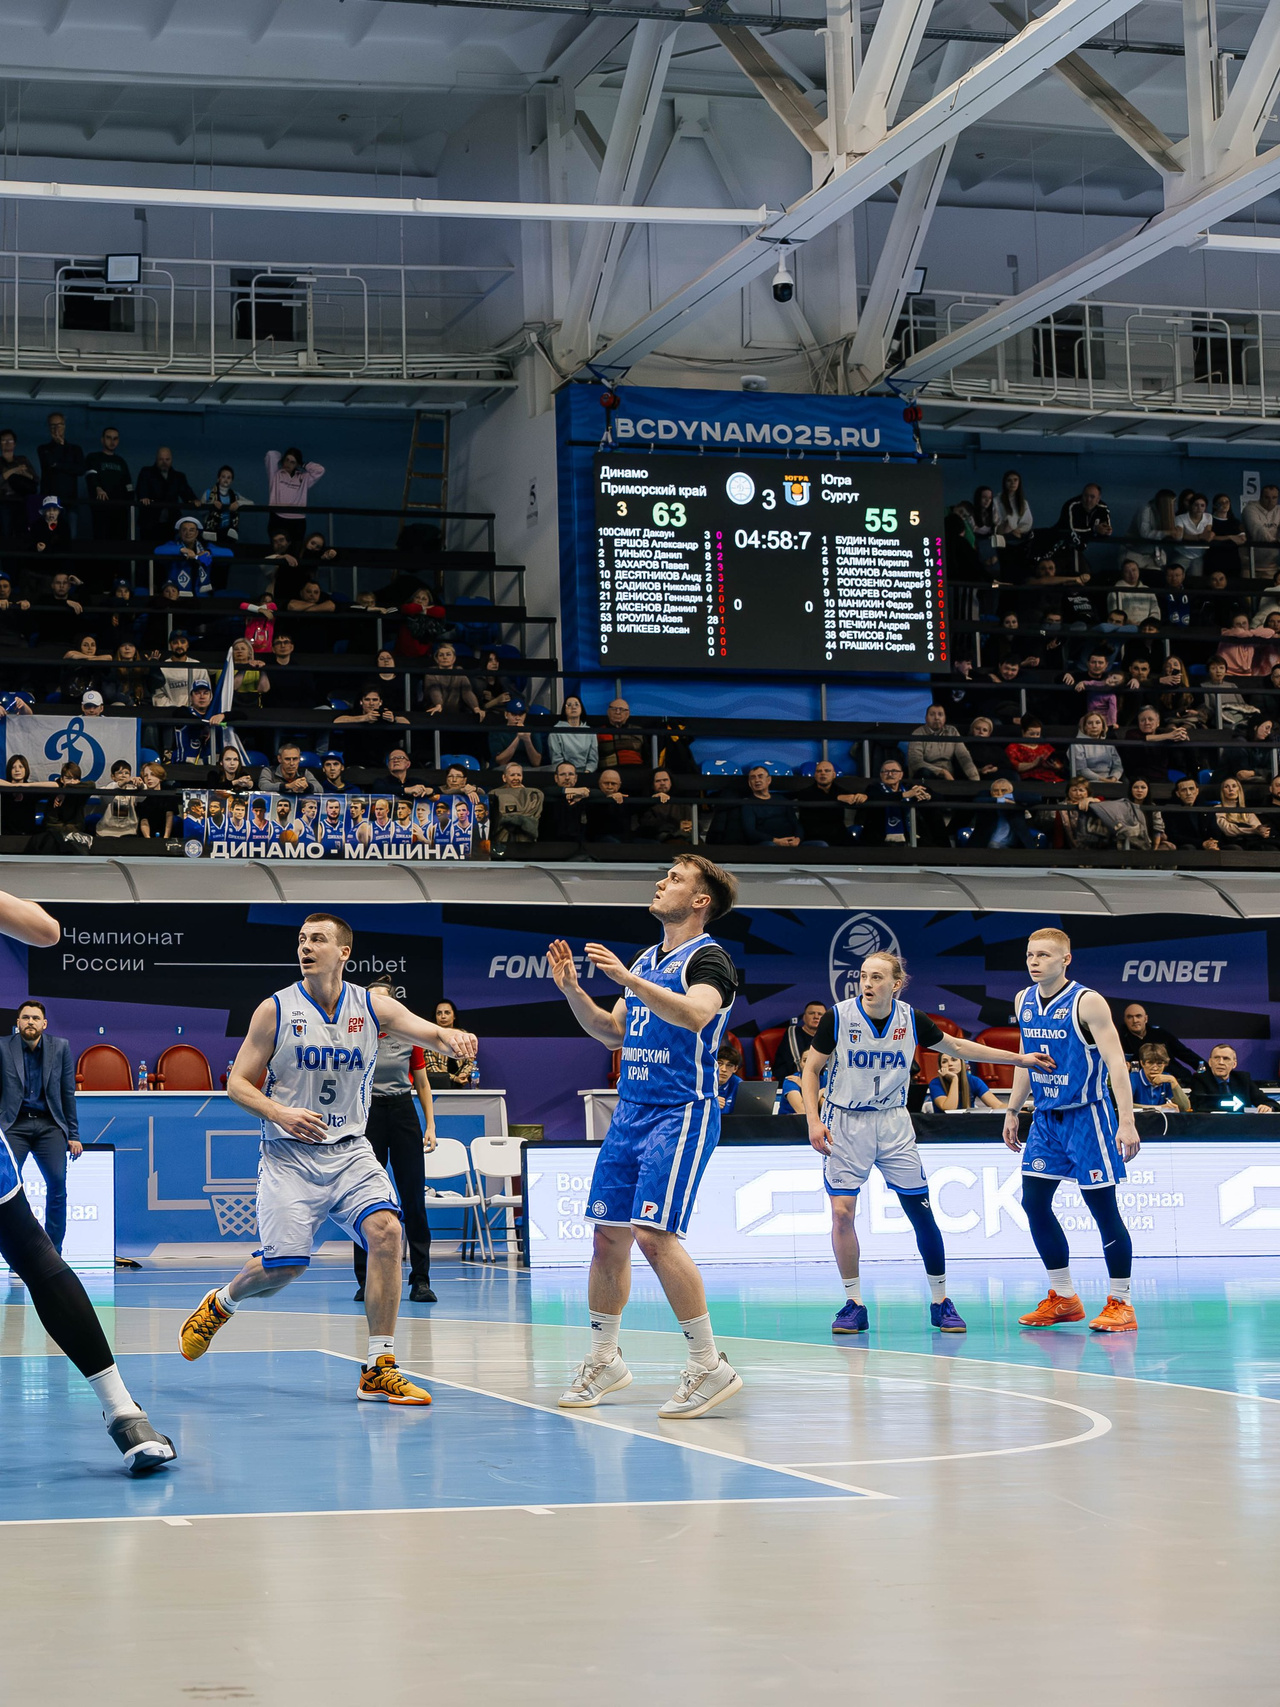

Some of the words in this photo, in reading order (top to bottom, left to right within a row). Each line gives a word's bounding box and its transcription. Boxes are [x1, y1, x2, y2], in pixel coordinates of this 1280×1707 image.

[615, 417, 881, 448] BCDYNAMO25.RU
[600, 465, 649, 479] Динамо
[821, 474, 852, 487] Югра
[1246, 477, 1257, 495] 5
[601, 482, 676, 497] Приморский
[679, 485, 707, 498] край
[762, 489, 776, 510] 3
[821, 490, 859, 503] Сургут
[617, 501, 628, 516] 3
[652, 502, 687, 527] 63
[865, 508, 898, 532] 55
[909, 511, 920, 526] 5
[704, 531, 711, 539] 3
[734, 529, 812, 550] 04:58:7
[614, 538, 649, 548] ЕРШОВ
[651, 540, 699, 551] Александр
[704, 541, 711, 550] 9
[836, 536, 866, 546] БУДИН
[868, 537, 900, 547] Кирилл
[598, 549, 605, 557] 2
[614, 549, 652, 558] ГИНЬКО
[705, 552, 711, 560] 8
[822, 547, 828, 555] 2
[836, 547, 870, 555] ТИШИН
[872, 548, 913, 558] Всеволод
[599, 559, 605, 568] 3
[615, 559, 659, 569] ЗАХАРОВ
[661, 561, 689, 570] Павел
[705, 563, 711, 571] 2
[822, 557, 829, 565] 5
[836, 557, 876, 566] САЛМИН
[878, 558, 909, 568] Кирилл
[600, 570, 610, 578] 10
[615, 570, 680, 580] ДЕСЯТНИКОВ
[705, 574, 712, 582] 2
[822, 567, 829, 576] 6
[837, 567, 880, 576] ХАКУНОВ
[600, 581, 611, 589] 16
[615, 581, 661, 591] САДИКОВ
[663, 583, 701, 592] Николай
[705, 584, 712, 592] 0
[823, 578, 829, 586] 7
[837, 578, 892, 588] РОГОЗЕНКО
[600, 592, 610, 600] 21
[615, 592, 662, 602] ДЕНИСОВ
[706, 595, 712, 603] 4
[823, 589, 829, 597] 9
[838, 588, 880, 598] ТОКАРЕВ
[881, 590, 911, 600] Сергей
[600, 602, 611, 611] 27
[616, 602, 661, 612] АКСЕНОВ
[663, 604, 697, 613] Даниил
[707, 605, 713, 613] 7
[733, 599, 742, 610] 0
[805, 601, 813, 613] 0
[824, 599, 835, 607] 10
[838, 599, 884, 608] МАНИХИН
[886, 600, 913, 610] Федор
[600, 613, 612, 621] 53
[616, 613, 654, 622] КРОУЛИ
[656, 614, 683, 623] Айзея
[707, 616, 718, 624] 28
[824, 610, 835, 618] 22
[839, 610, 887, 620] КУРЦЕВИЧ
[889, 611, 924, 620] Алексей
[600, 624, 612, 632] 86
[617, 624, 660, 633] КИПКЕЕВ
[662, 625, 690, 634] Хасан
[825, 620, 836, 628] 23
[839, 620, 876, 629] ПЕЧКИН
[878, 621, 910, 631] Андрей
[825, 631, 836, 639] 38
[839, 631, 884, 640] ФЕТИСОВ
[886, 632, 903, 641] Лев
[825, 641, 836, 649] 44
[840, 641, 883, 650] ГРАШКИН
[885, 642, 915, 652] Сергей
[210, 841, 324, 859] ДИНАМО
[344, 843, 466, 860] МАШИНА!
[63, 927, 184, 945] Чемпионат
[62, 953, 144, 971] России
[344, 955, 407, 973] onbet
[489, 955, 596, 979] FONET
[1122, 960, 1227, 982] FONBET
[349, 1017, 364, 1025] FON
[348, 1025, 363, 1033] BET
[295, 1045, 365, 1071] ЮГРА
[847, 1049, 907, 1069] ЮГРА
[628, 1064, 649, 1081] КРАЙ
[318, 1079, 337, 1105] 5
[874, 1076, 880, 1096] 1
